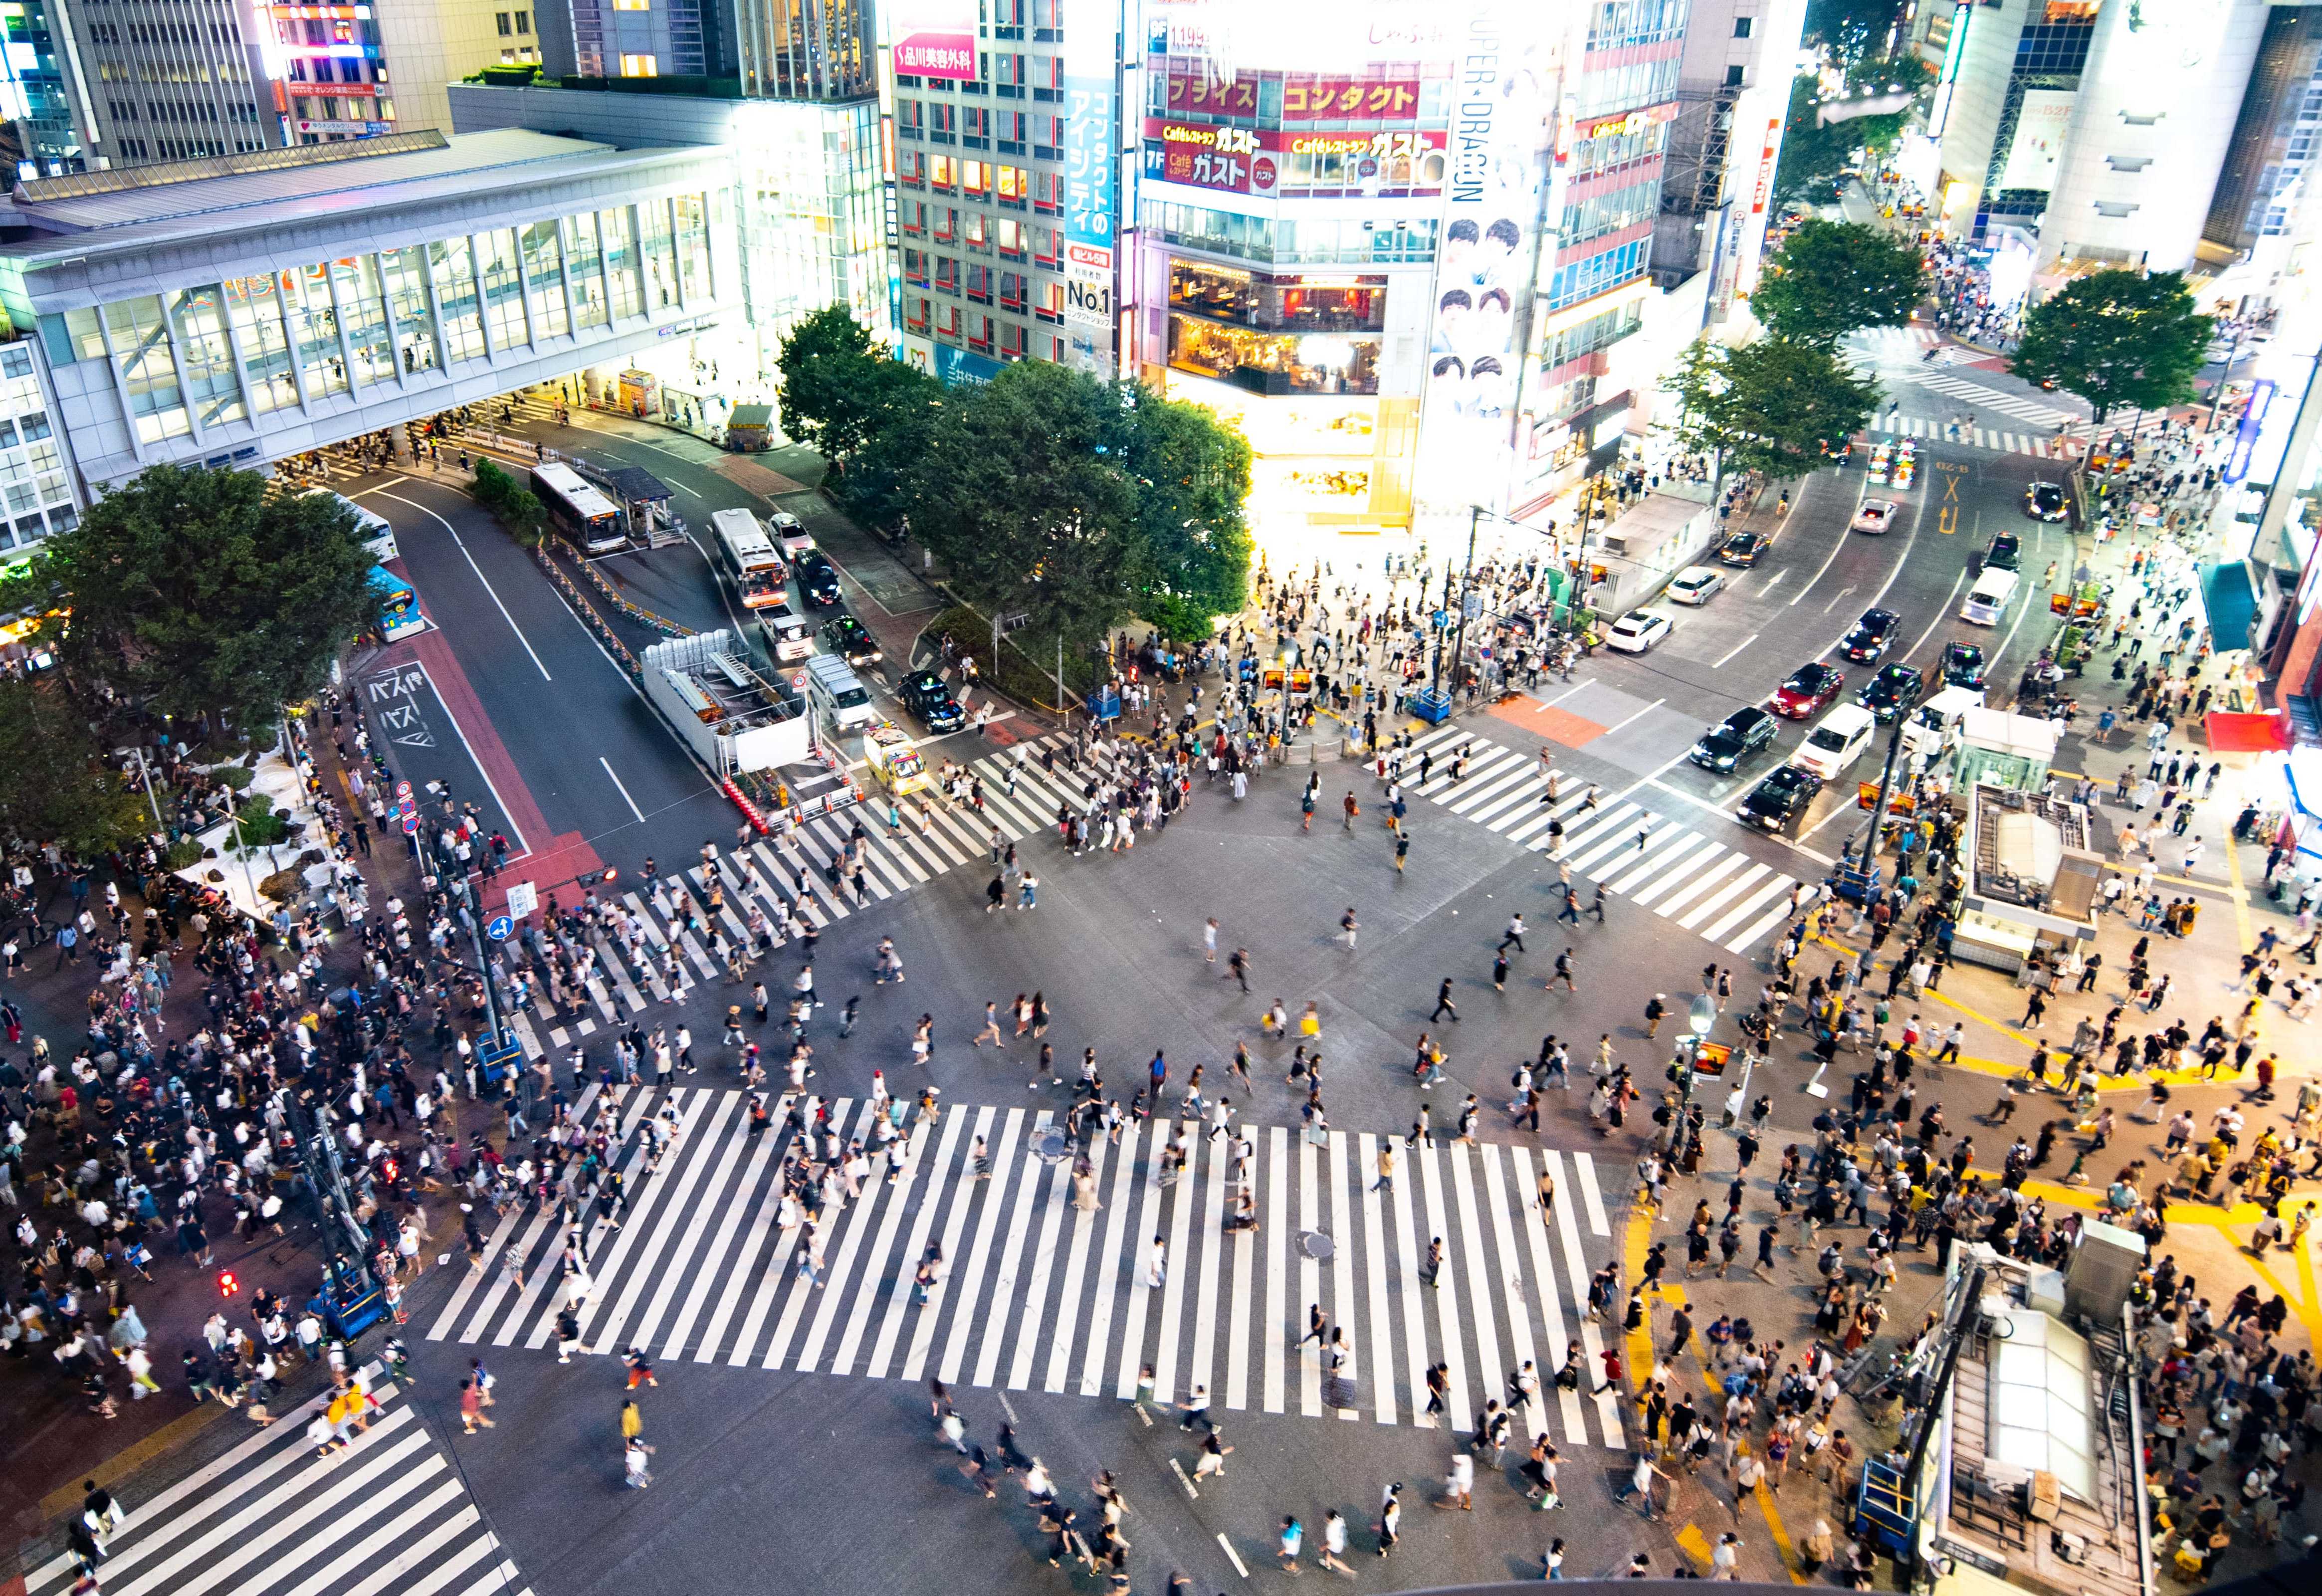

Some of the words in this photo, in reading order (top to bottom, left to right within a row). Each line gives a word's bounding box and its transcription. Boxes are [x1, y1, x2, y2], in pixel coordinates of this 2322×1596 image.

[905, 46, 971, 71] 品川美容外科
[1170, 78, 1255, 109] プライス
[1284, 85, 1414, 112] コンタクト
[1216, 126, 1261, 156] ガスト
[1369, 132, 1433, 158] ガスト
[1452, 103, 1493, 201] DRAGON
[1069, 89, 1090, 232] アイシティ
[1093, 91, 1109, 235] コンタクトの
[1146, 150, 1165, 170] 7F
[1169, 153, 1192, 169] Café
[1192, 153, 1246, 187] ガスト
[1256, 169, 1274, 182] ガスト
[1067, 278, 1110, 316] No.1
[1066, 309, 1110, 327] コンタクトショップ
[380, 705, 419, 730] バス
